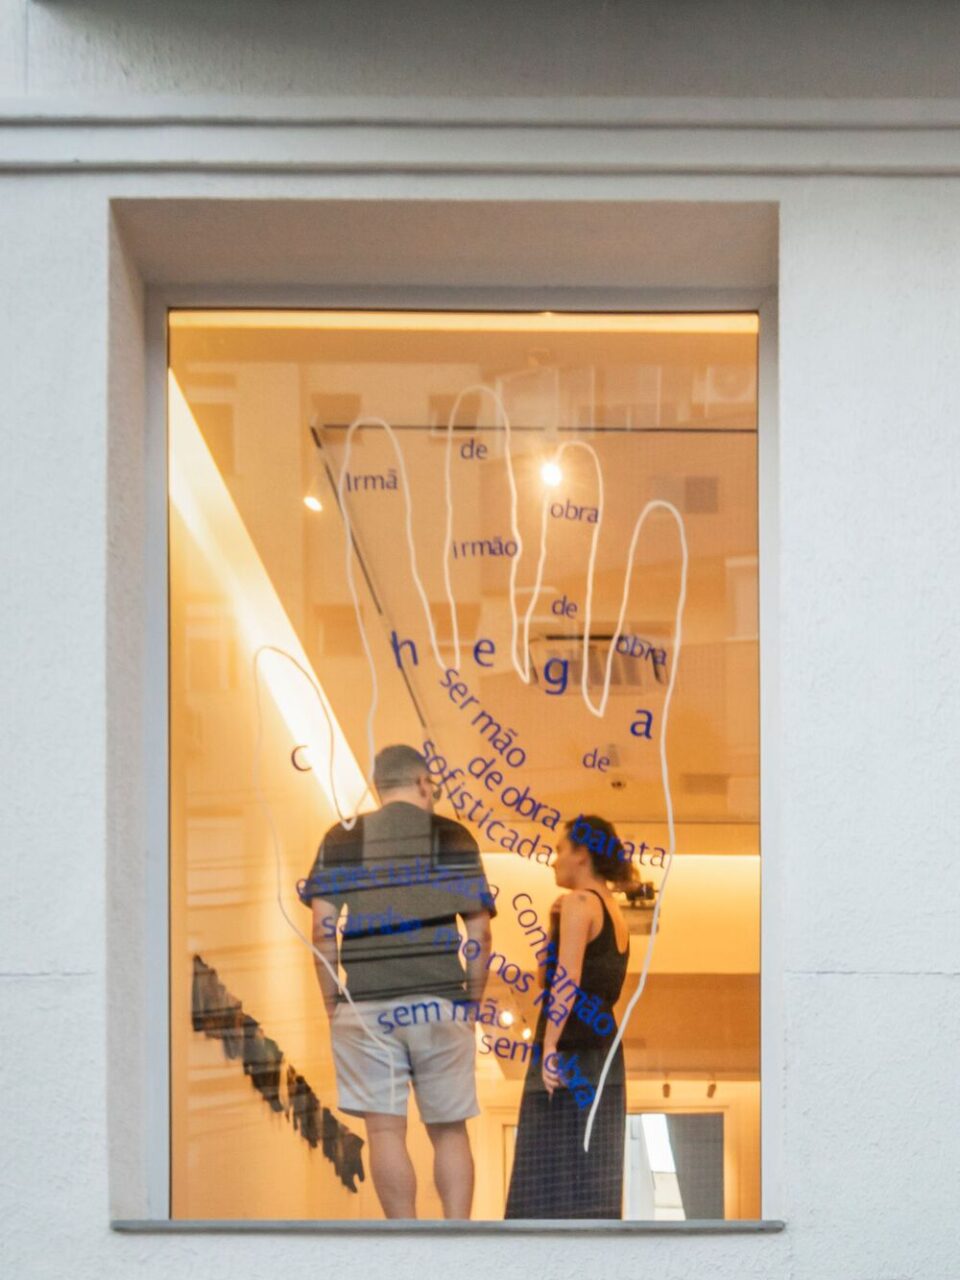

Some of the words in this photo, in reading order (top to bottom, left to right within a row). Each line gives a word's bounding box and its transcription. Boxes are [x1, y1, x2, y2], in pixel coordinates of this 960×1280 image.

[460, 439, 488, 459] de
[550, 501, 600, 523] obra
[551, 595, 578, 618] de
[615, 635, 667, 666] obra
[439, 668, 480, 710] ser
[471, 709, 527, 768] mão
[582, 748, 610, 772] de
[416, 740, 553, 866] sofisticada
[467, 756, 503, 791] de
[500, 787, 561, 831] obra
[569, 814, 667, 868] barata
[512, 893, 615, 1036] contramão
[377, 1000, 440, 1034] sem
[478, 1034, 541, 1068] sem
